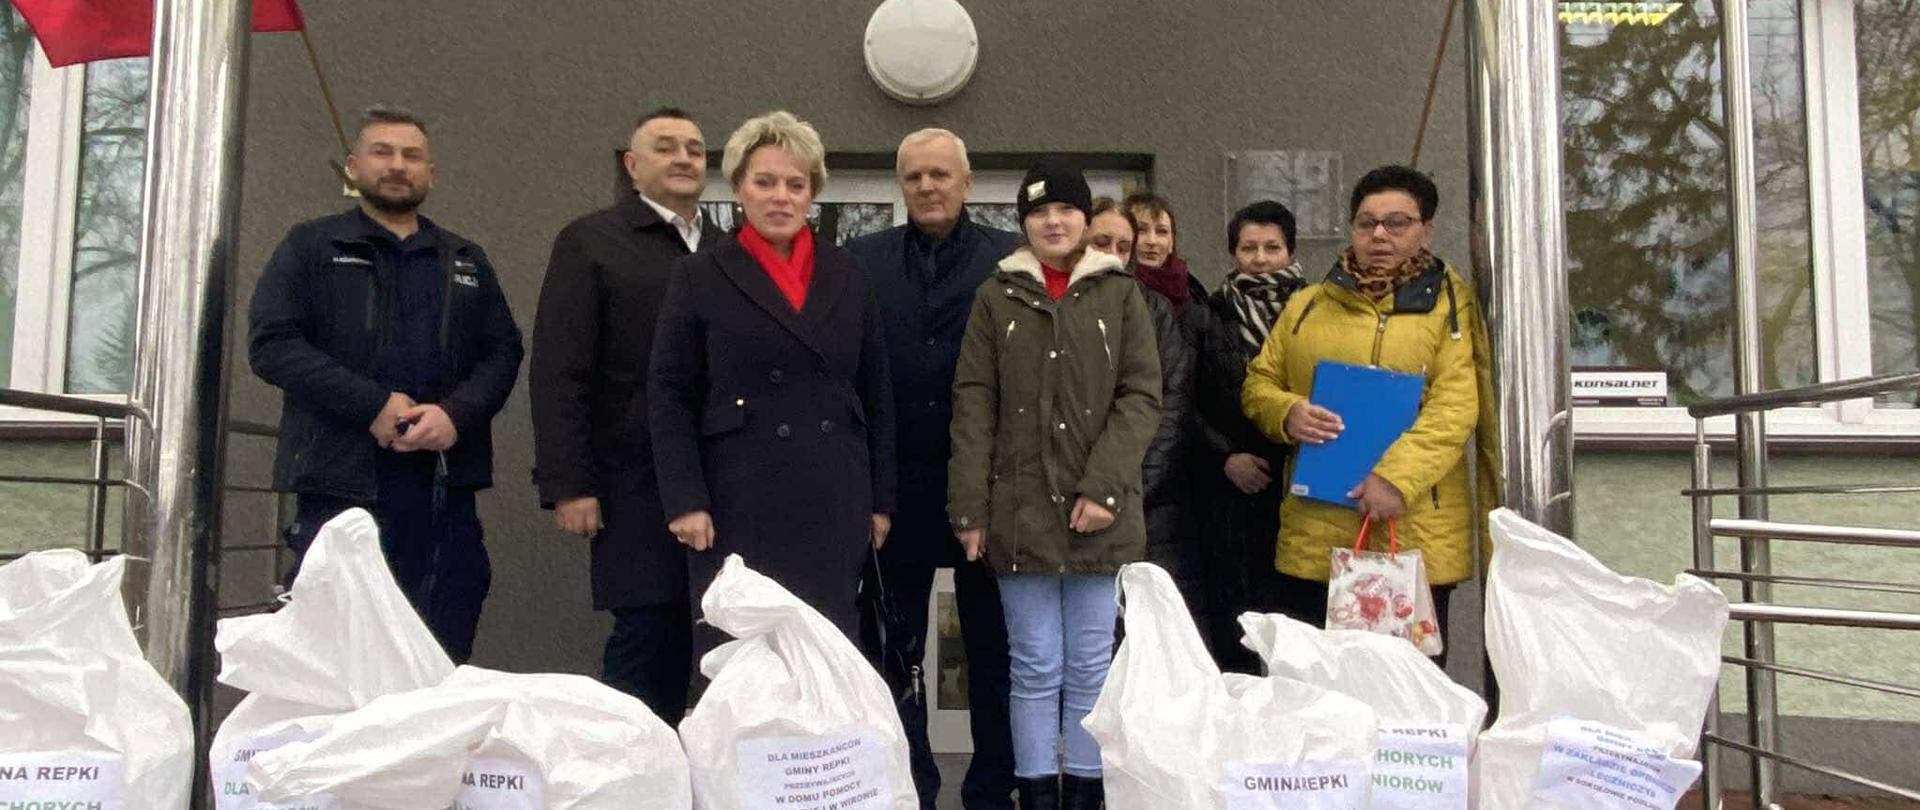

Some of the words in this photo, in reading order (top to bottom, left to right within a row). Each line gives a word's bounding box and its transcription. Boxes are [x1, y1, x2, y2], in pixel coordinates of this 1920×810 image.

[767, 753, 788, 762] DLA
[37, 766, 99, 780] REPKI
[785, 765, 819, 776] GMINY
[823, 756, 850, 771] REPKI
[224, 782, 249, 795] DLA
[480, 773, 524, 790] REPKI
[775, 796, 785, 804] W
[788, 793, 819, 803] DOMU
[823, 781, 862, 798] POMOCY
